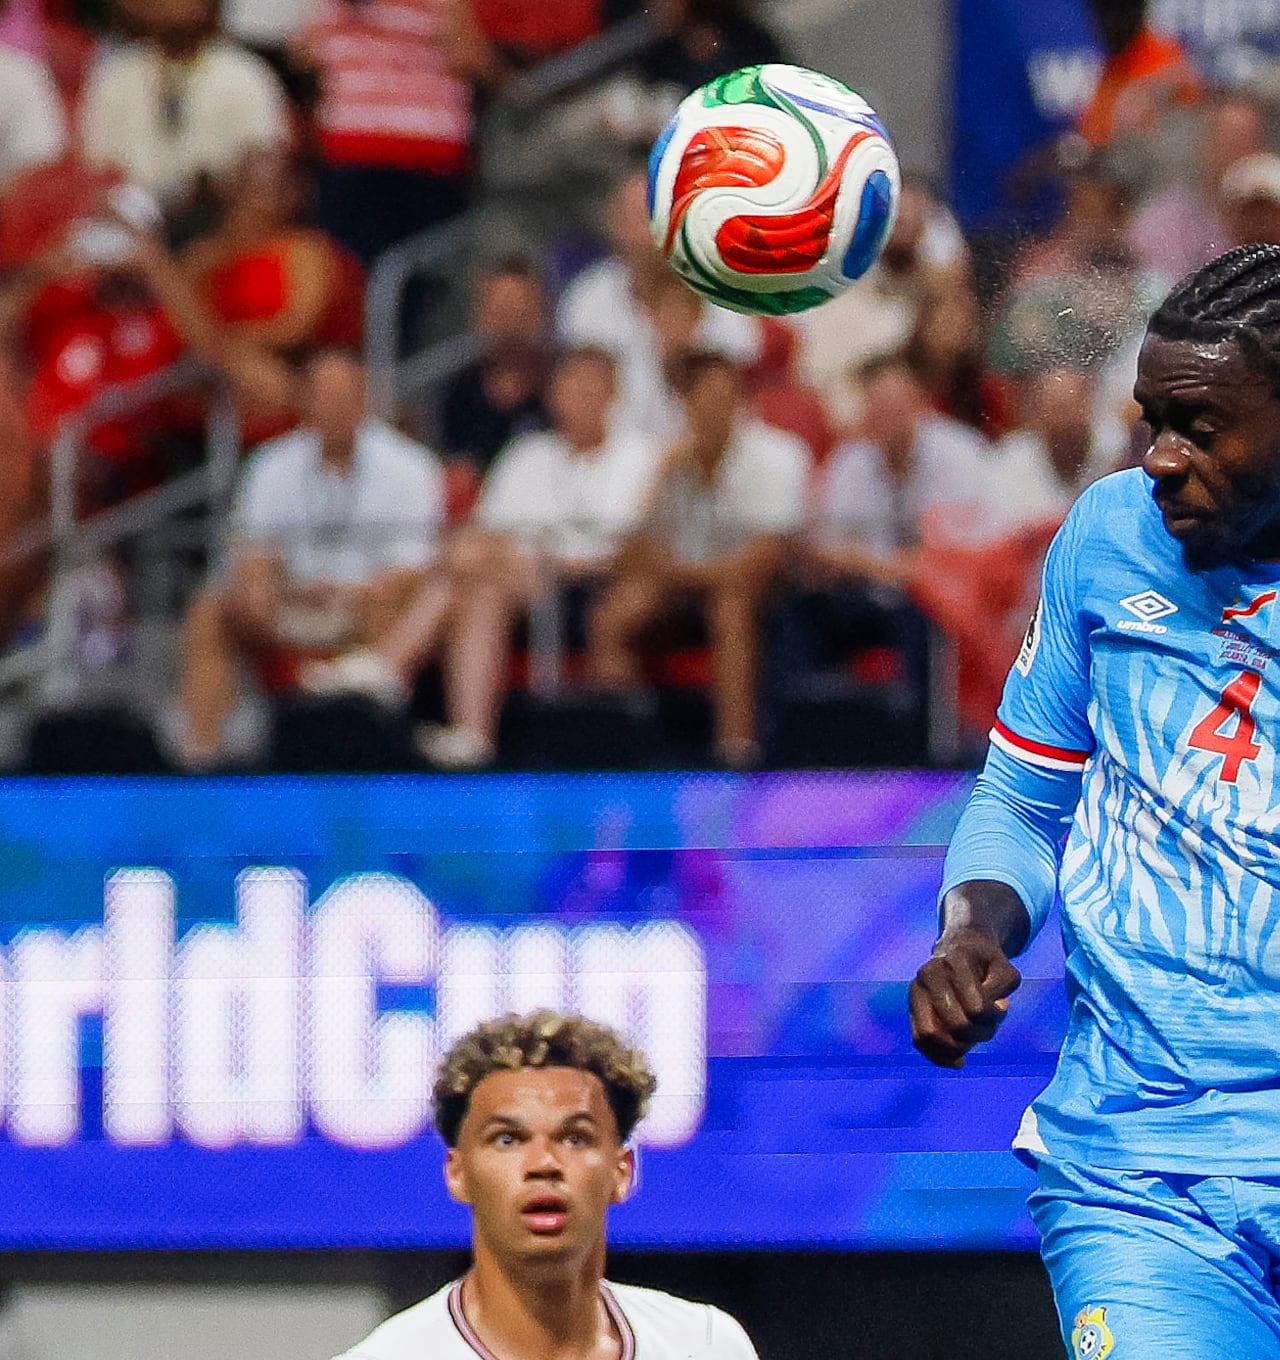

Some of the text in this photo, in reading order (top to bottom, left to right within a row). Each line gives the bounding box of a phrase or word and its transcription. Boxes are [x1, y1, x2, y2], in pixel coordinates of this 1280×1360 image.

[1115, 620, 1168, 634] umbro
[1187, 671, 1262, 784] 4
[0, 866, 706, 1147] rldCp
